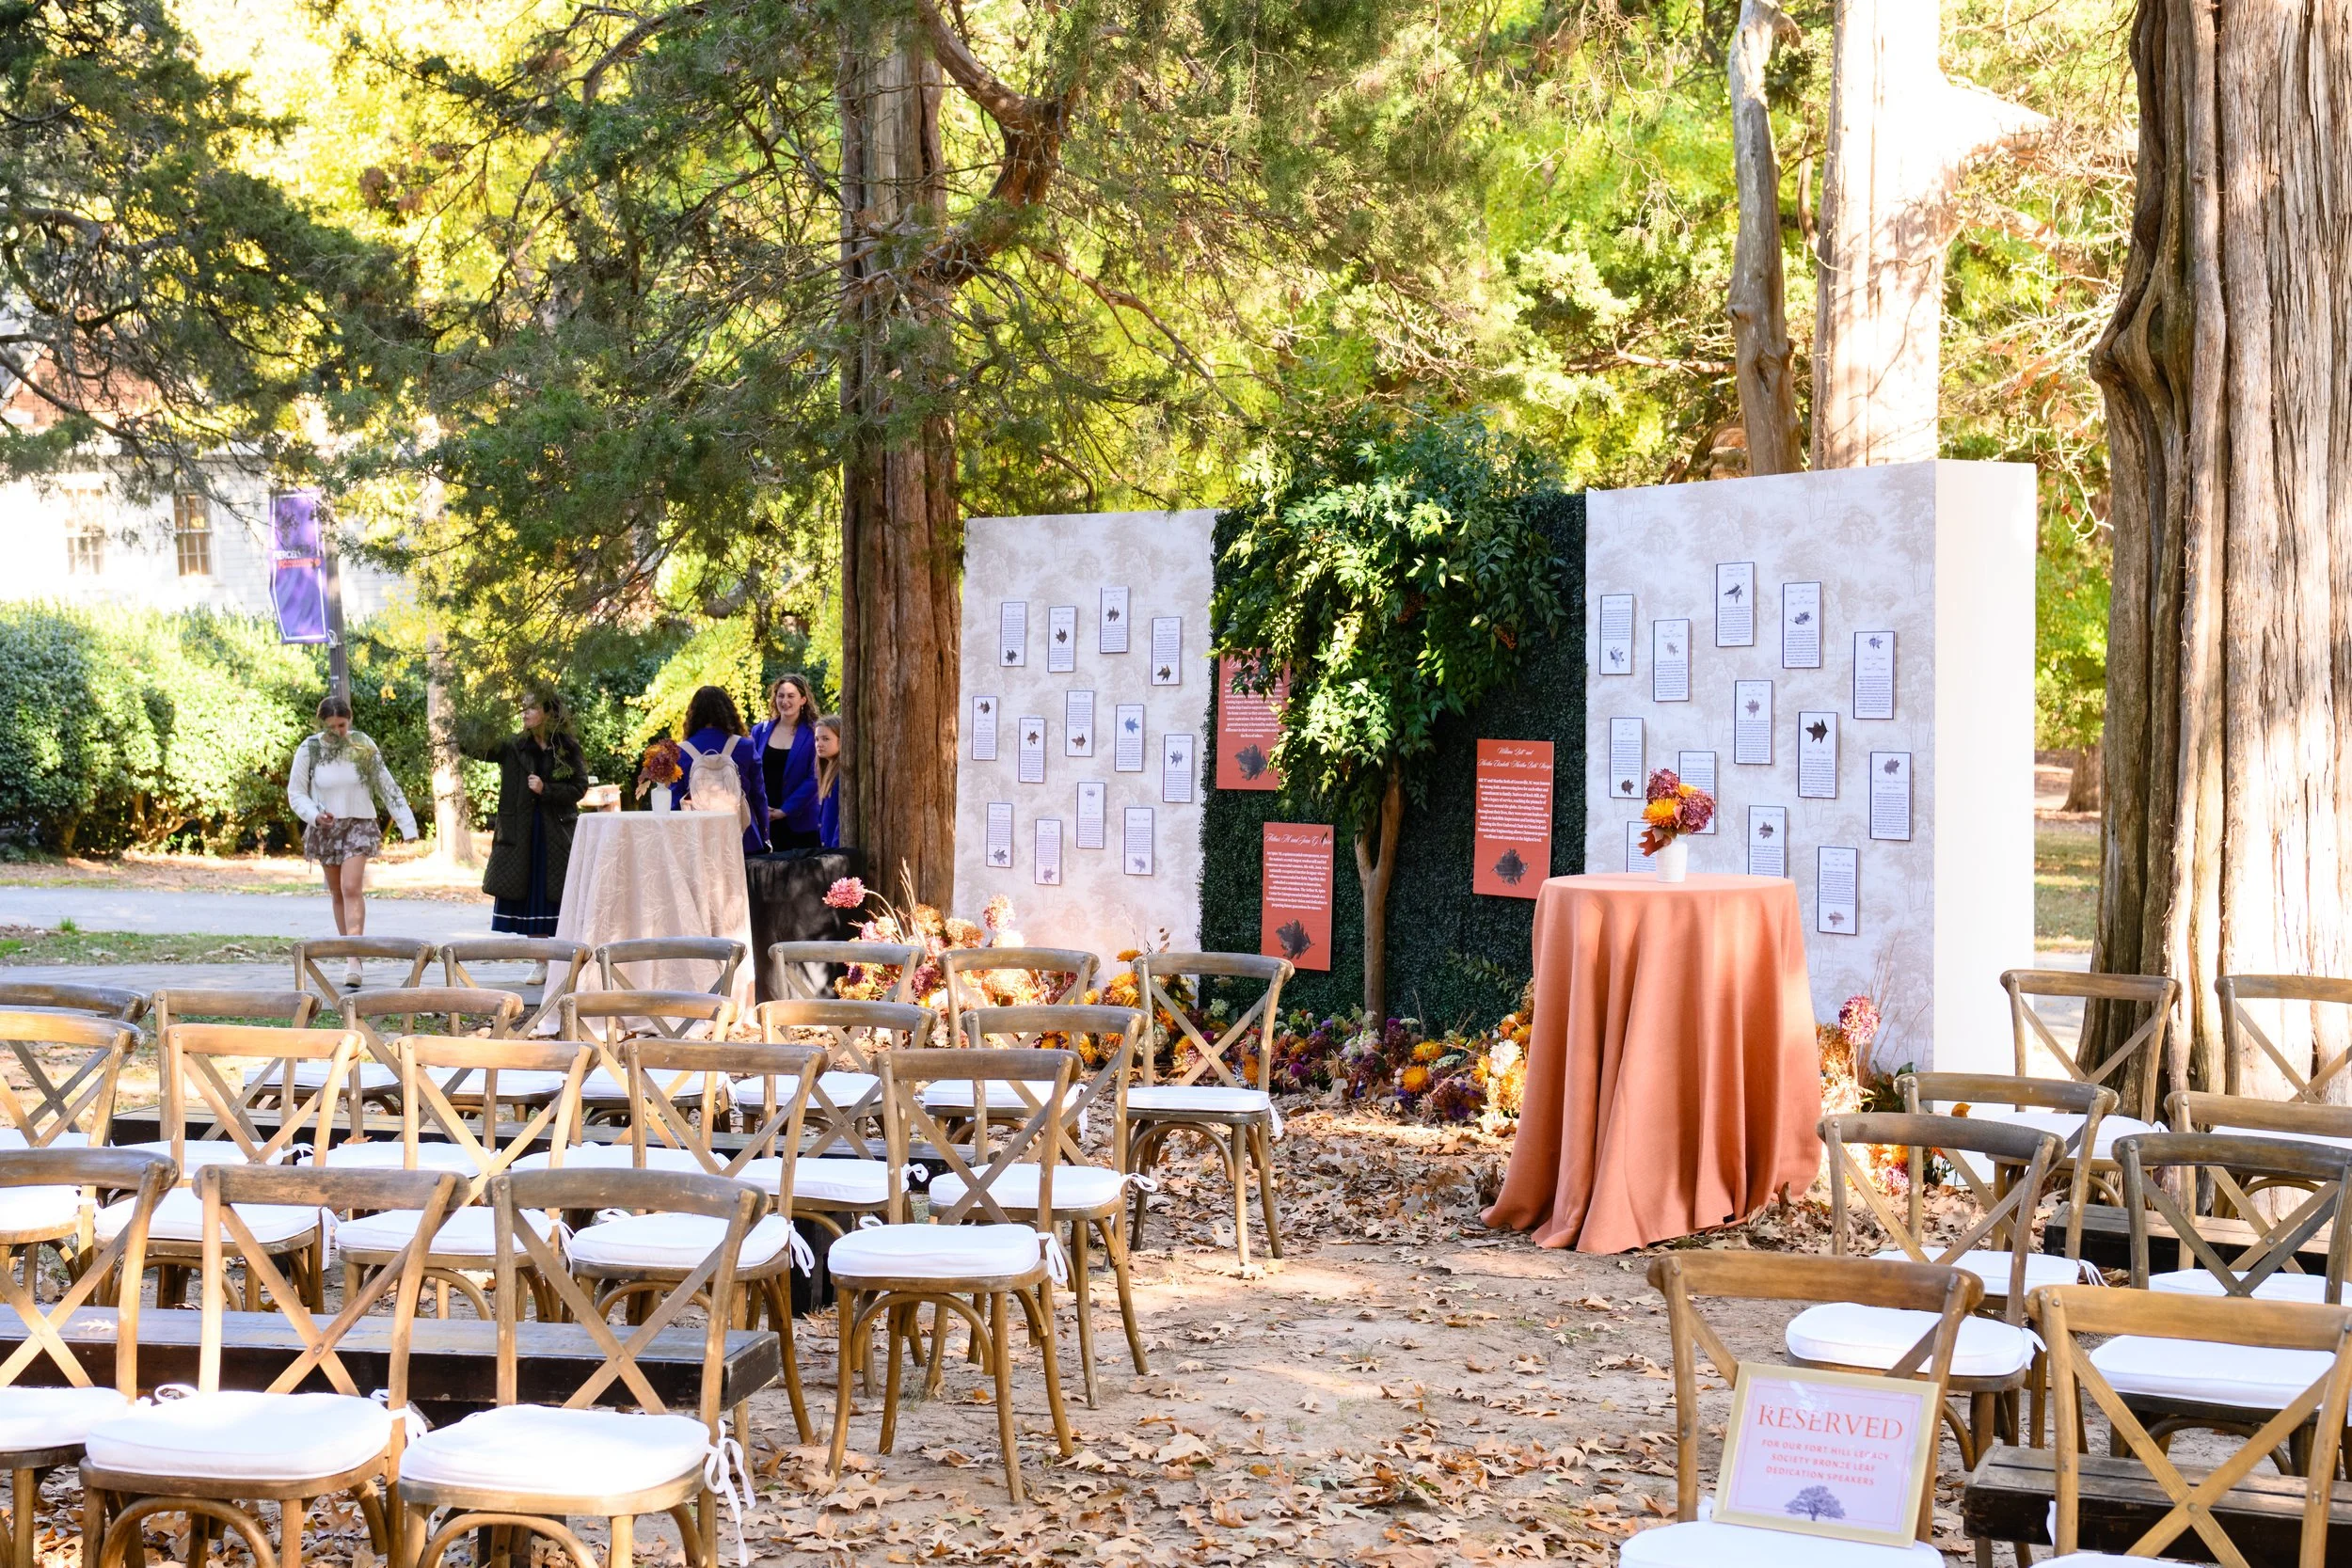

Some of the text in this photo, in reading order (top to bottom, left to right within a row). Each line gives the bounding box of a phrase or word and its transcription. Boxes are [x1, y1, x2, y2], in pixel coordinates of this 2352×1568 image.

[1757, 1404, 1903, 1440] RESERVED
[1761, 1439, 1780, 1448] FOR
[1782, 1441, 1802, 1450] OUR
[1804, 1444, 1828, 1453] FORT
[1831, 1447, 1851, 1456] HILL
[1772, 1453, 1875, 1472] SOCIETY BRONZE LEAF
[1766, 1465, 1875, 1486] DEDICATION SPEAKERS
